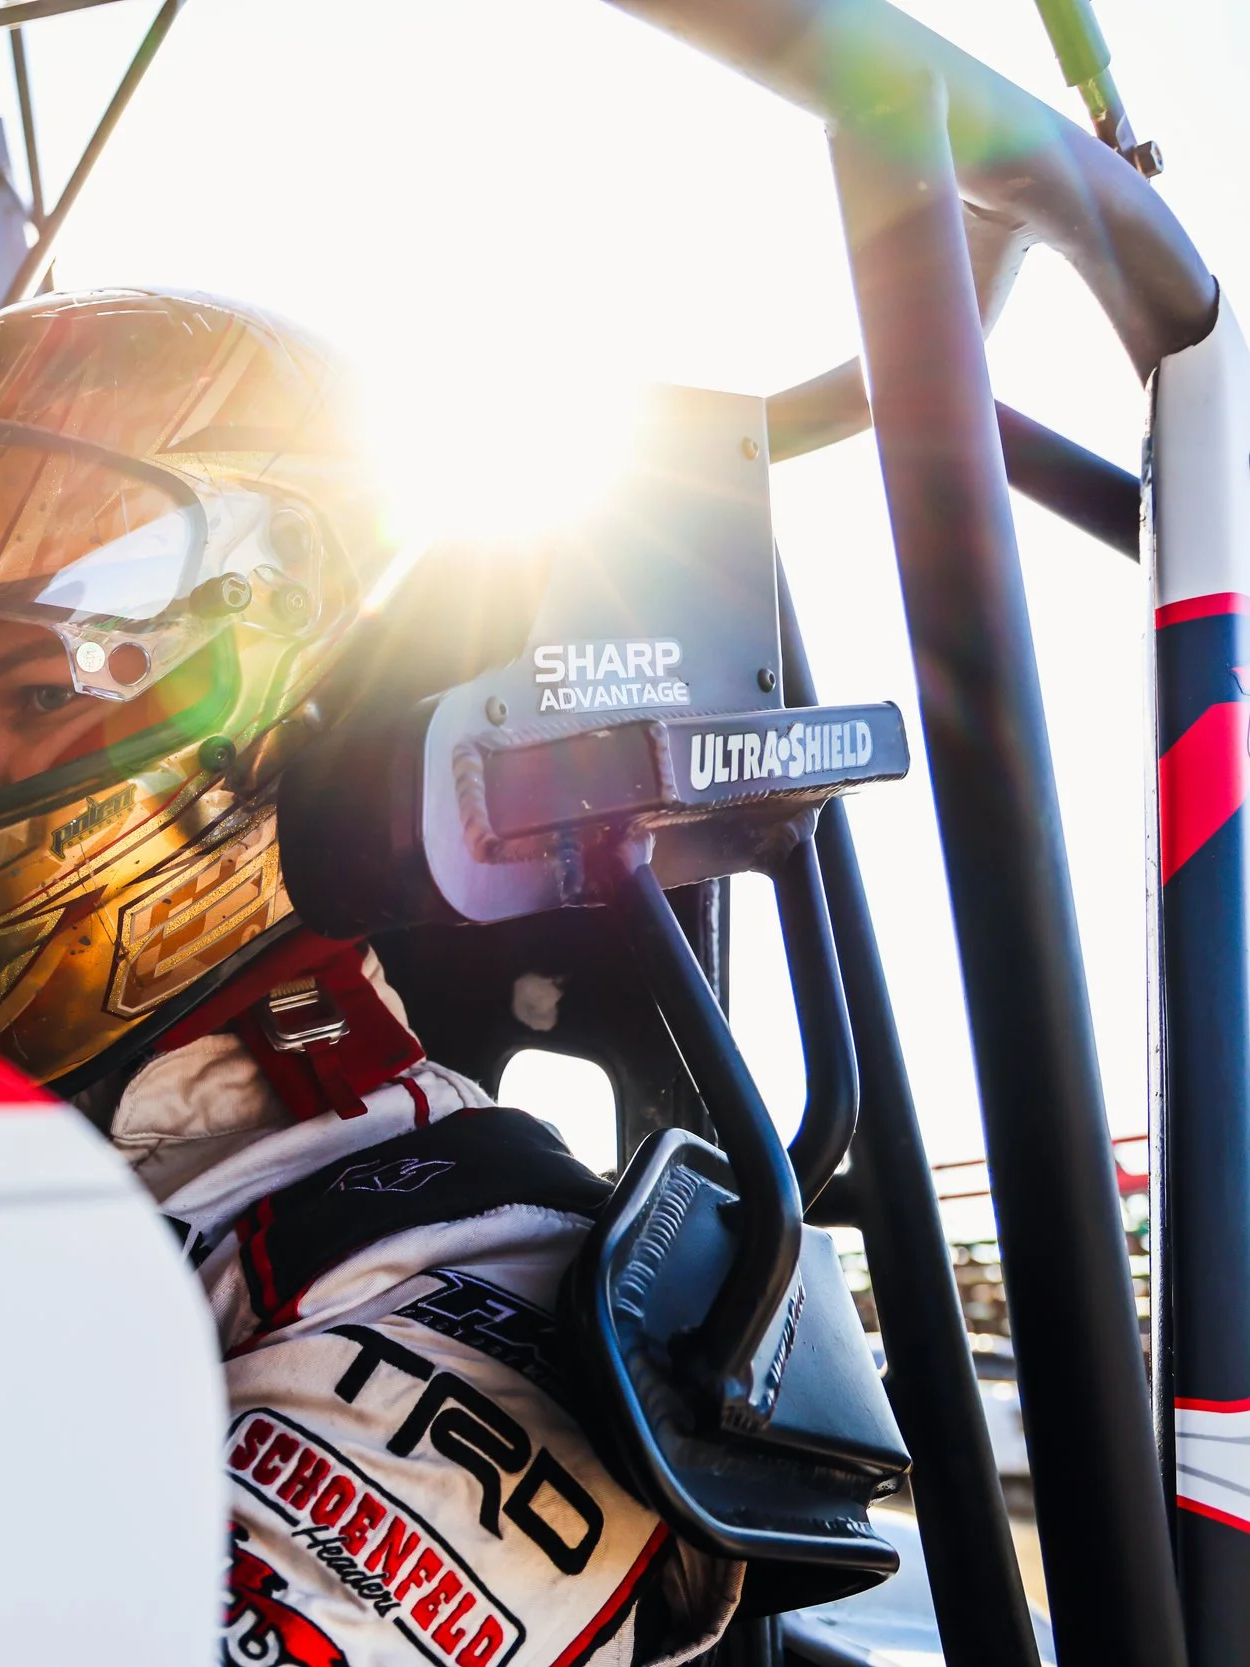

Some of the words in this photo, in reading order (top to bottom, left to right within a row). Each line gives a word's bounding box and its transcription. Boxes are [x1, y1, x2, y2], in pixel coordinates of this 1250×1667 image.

[534, 641, 681, 683] SHARP
[540, 682, 689, 712] ADVANTAGE
[323, 1324, 605, 1576] TRD
[229, 1418, 505, 1667] SCHOENFELD
[290, 1525, 402, 1618] Headers
